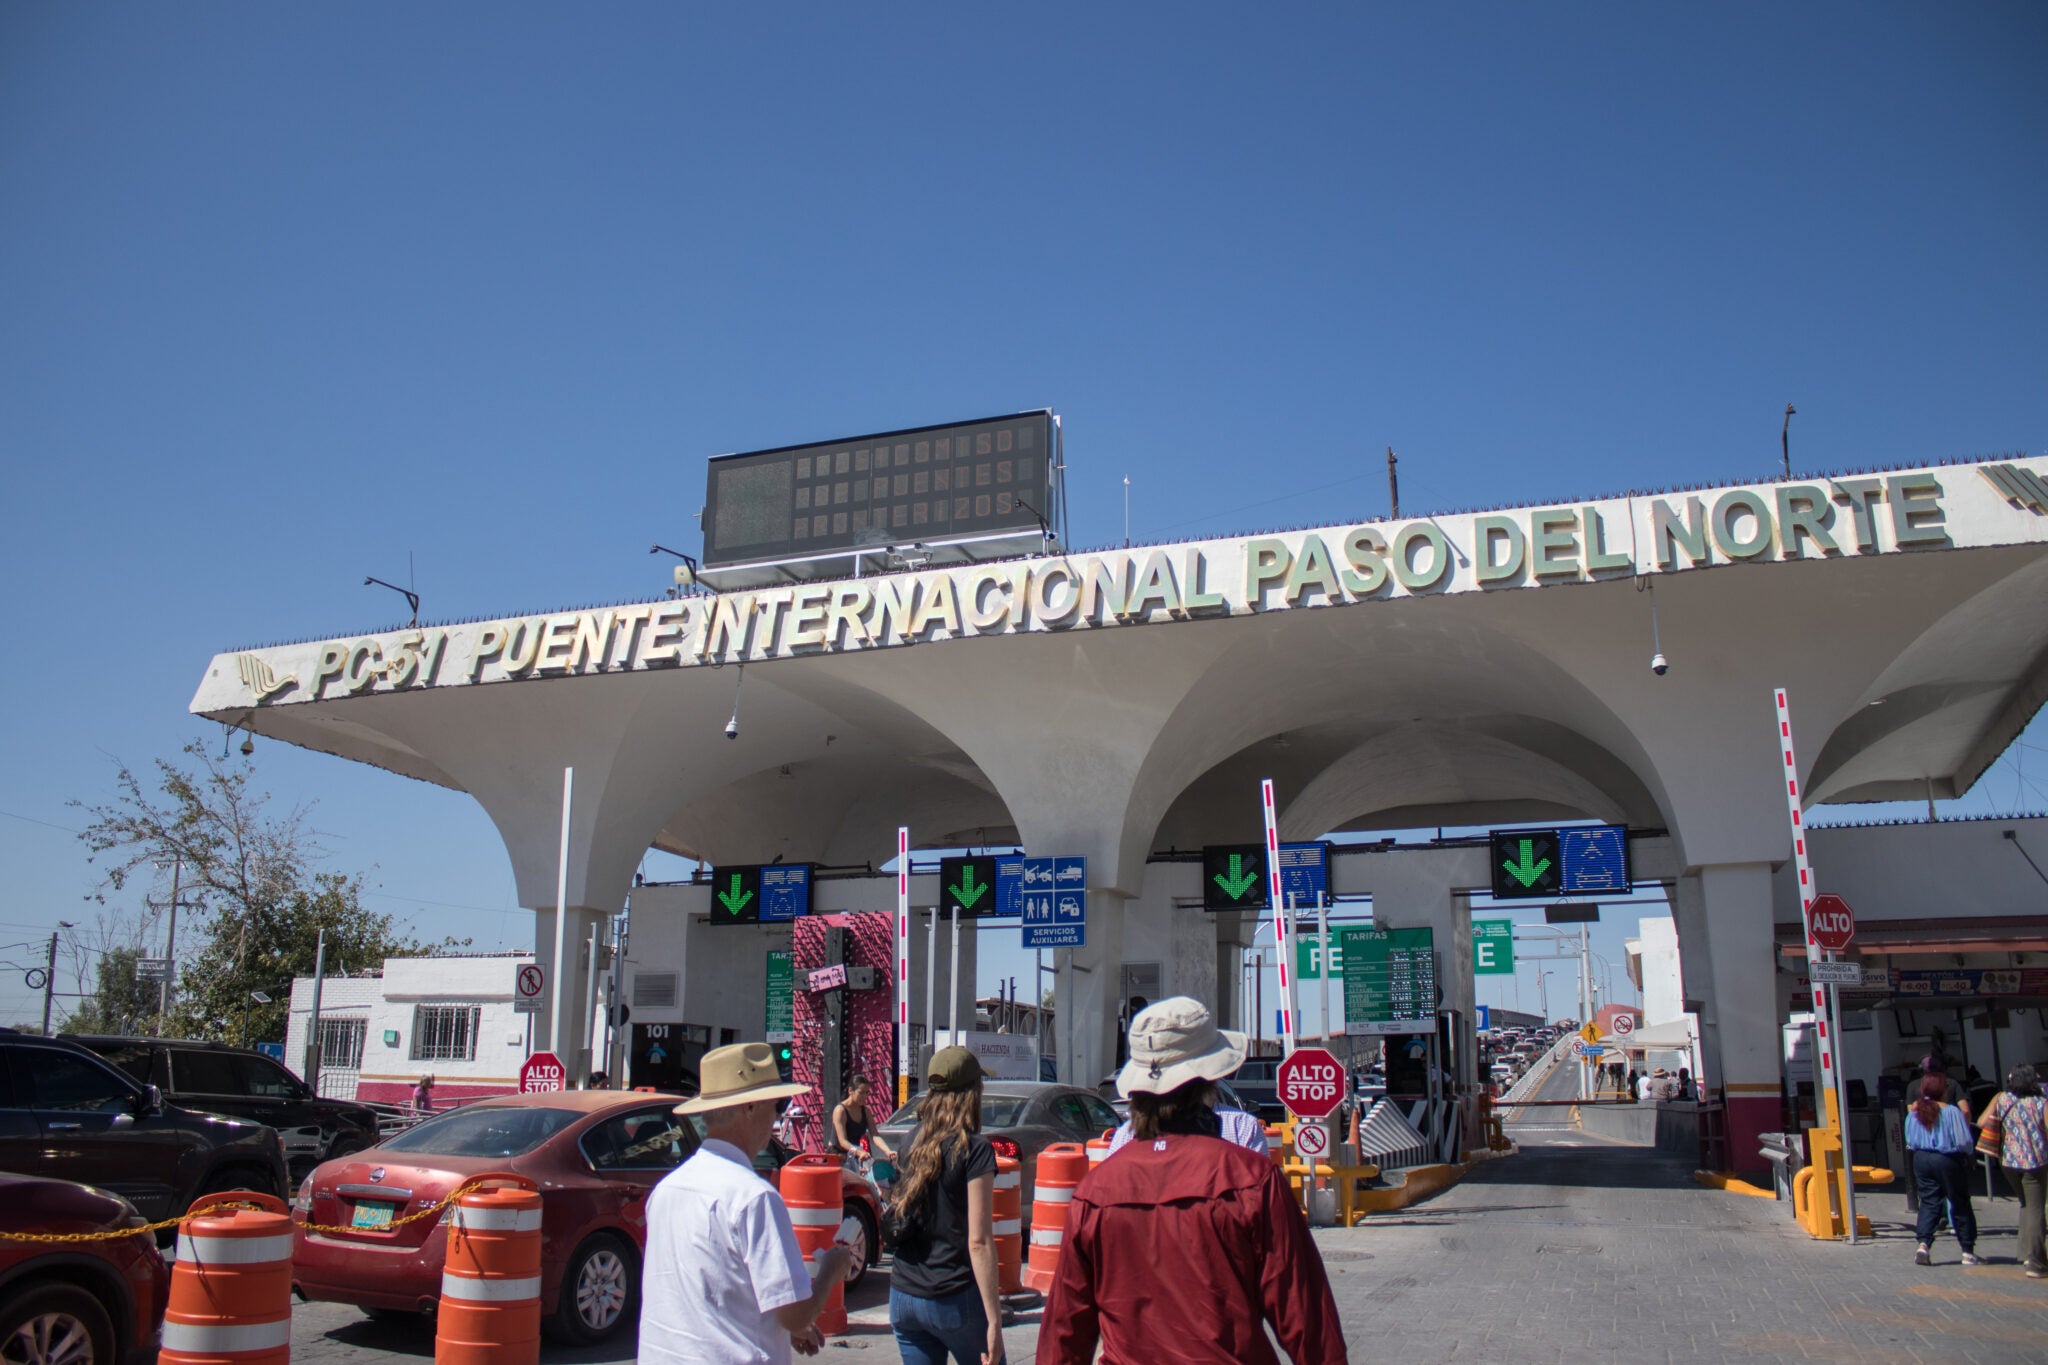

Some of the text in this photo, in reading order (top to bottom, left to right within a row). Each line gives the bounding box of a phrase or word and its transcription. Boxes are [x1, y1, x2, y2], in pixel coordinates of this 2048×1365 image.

[309, 472, 1949, 698] PC-51 PUENTE INTERNACIONAL PASO DEL NORTE
[1812, 912, 1851, 933] ALTO
[1033, 927, 1076, 936] SERVICIOS
[1346, 931, 1388, 941] TARIFAS
[1030, 935, 1079, 945] AUXILIARES
[1478, 942, 1495, 967] E
[1817, 965, 1852, 973] PROHIBIDA
[646, 1024, 669, 1038] 101
[981, 1044, 1010, 1055] HACIENDA
[526, 1065, 559, 1078] ALTO
[1287, 1065, 1335, 1080] ALTO
[525, 1082, 559, 1094] STOP
[1287, 1085, 1336, 1100] STOP
